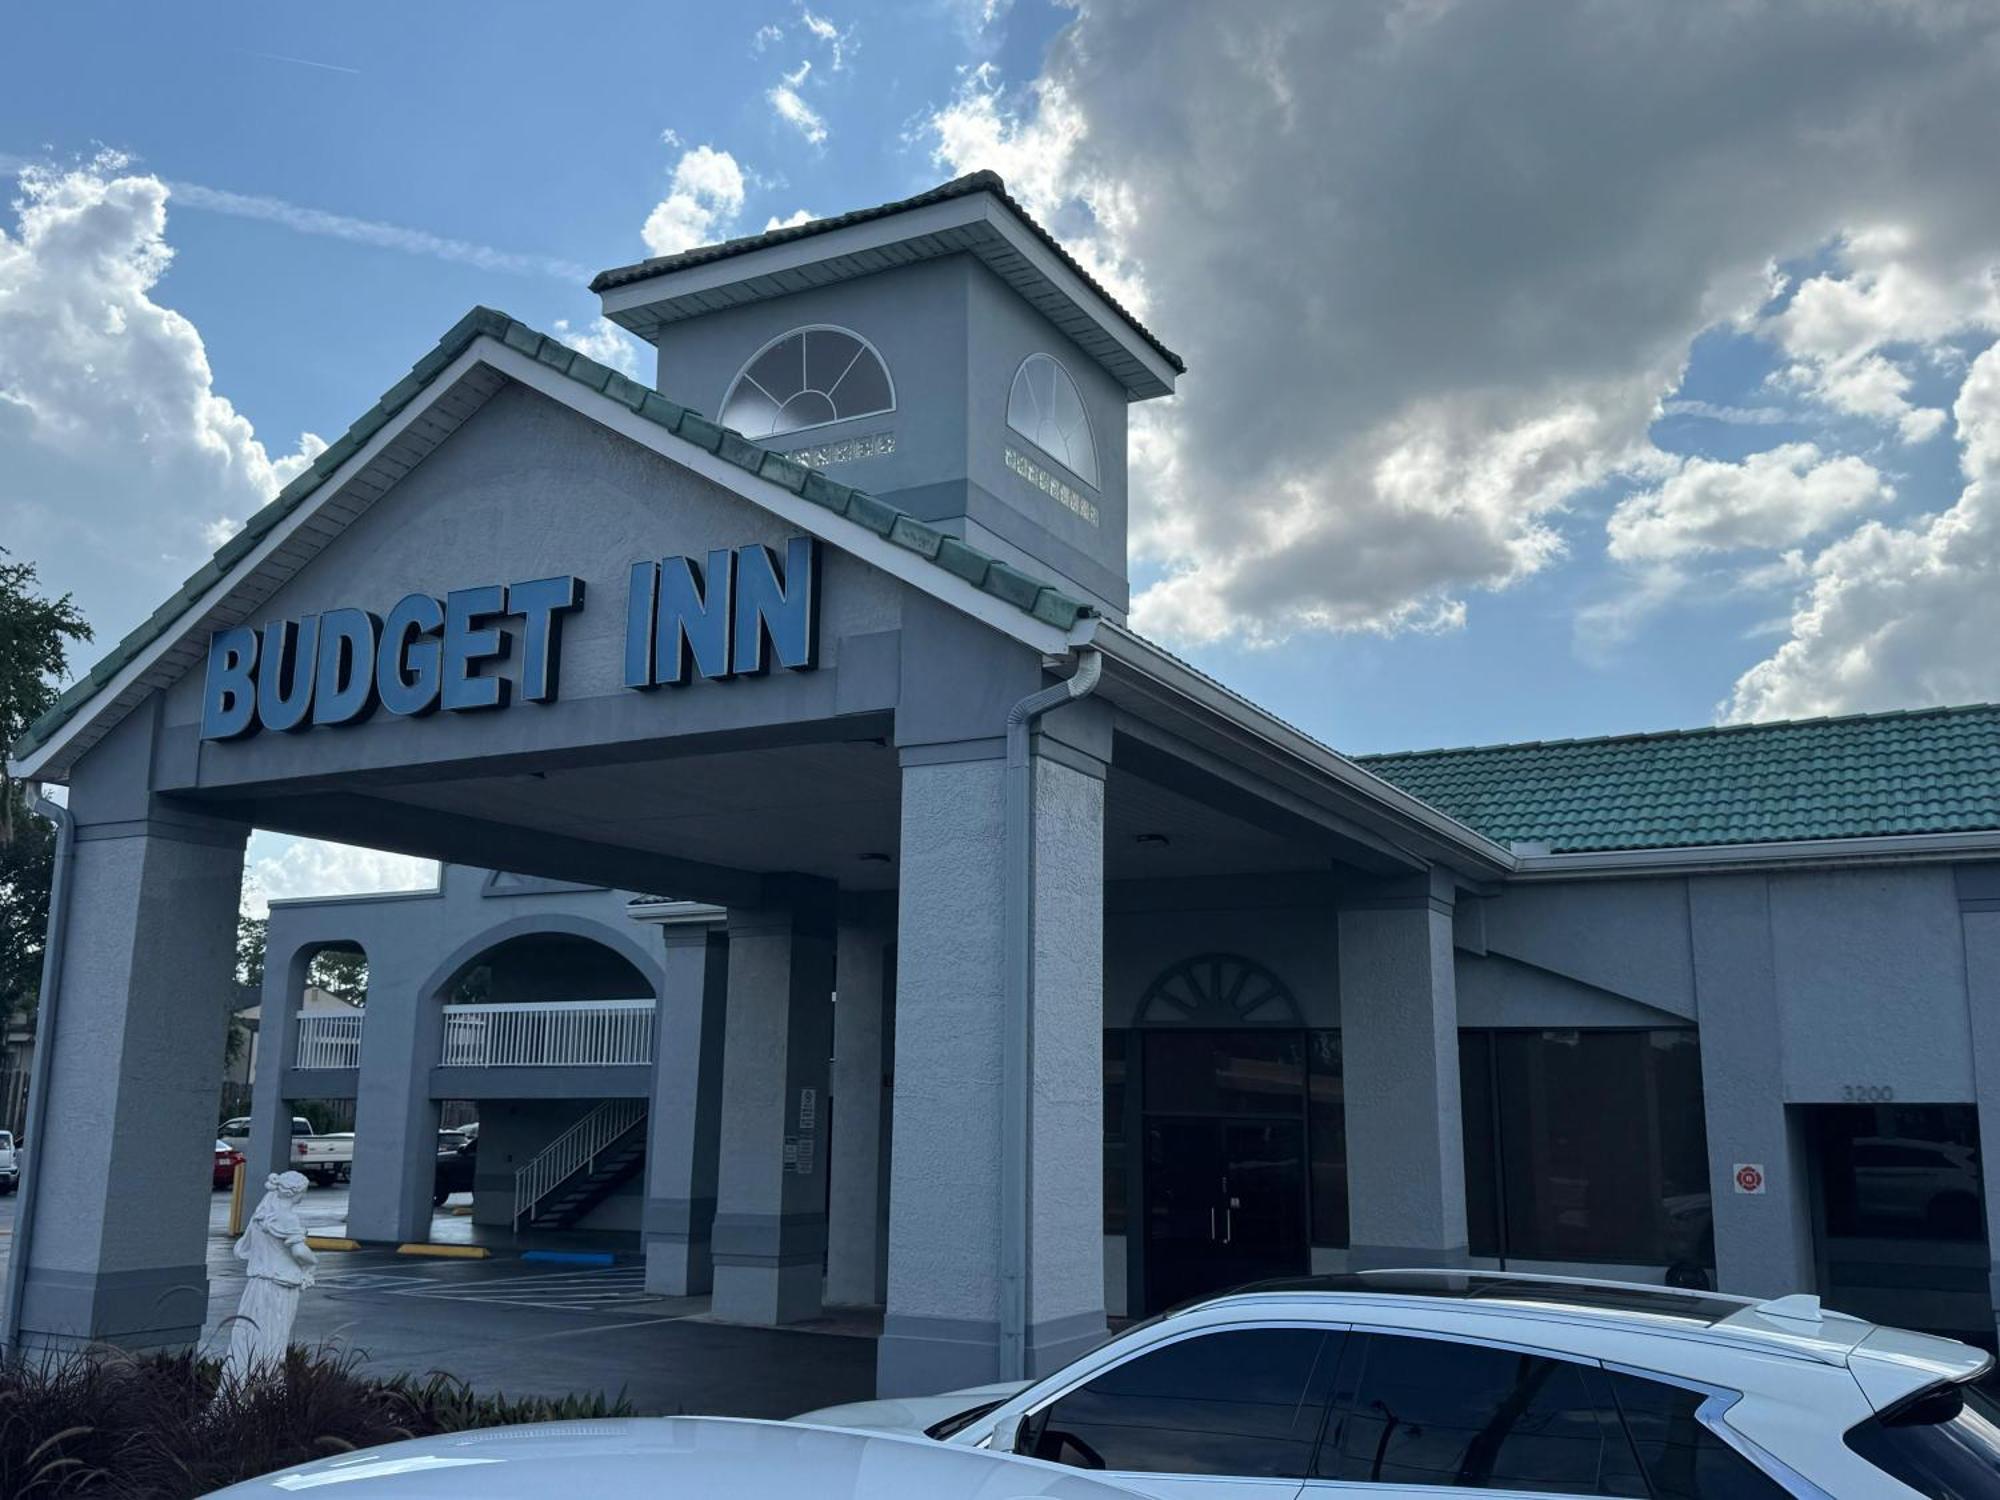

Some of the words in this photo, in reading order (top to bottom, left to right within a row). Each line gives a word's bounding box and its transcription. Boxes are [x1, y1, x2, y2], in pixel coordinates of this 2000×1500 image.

[201, 576, 582, 742] BUDGET
[624, 538, 818, 688] INN
[1842, 1085, 1894, 1102] 3200
